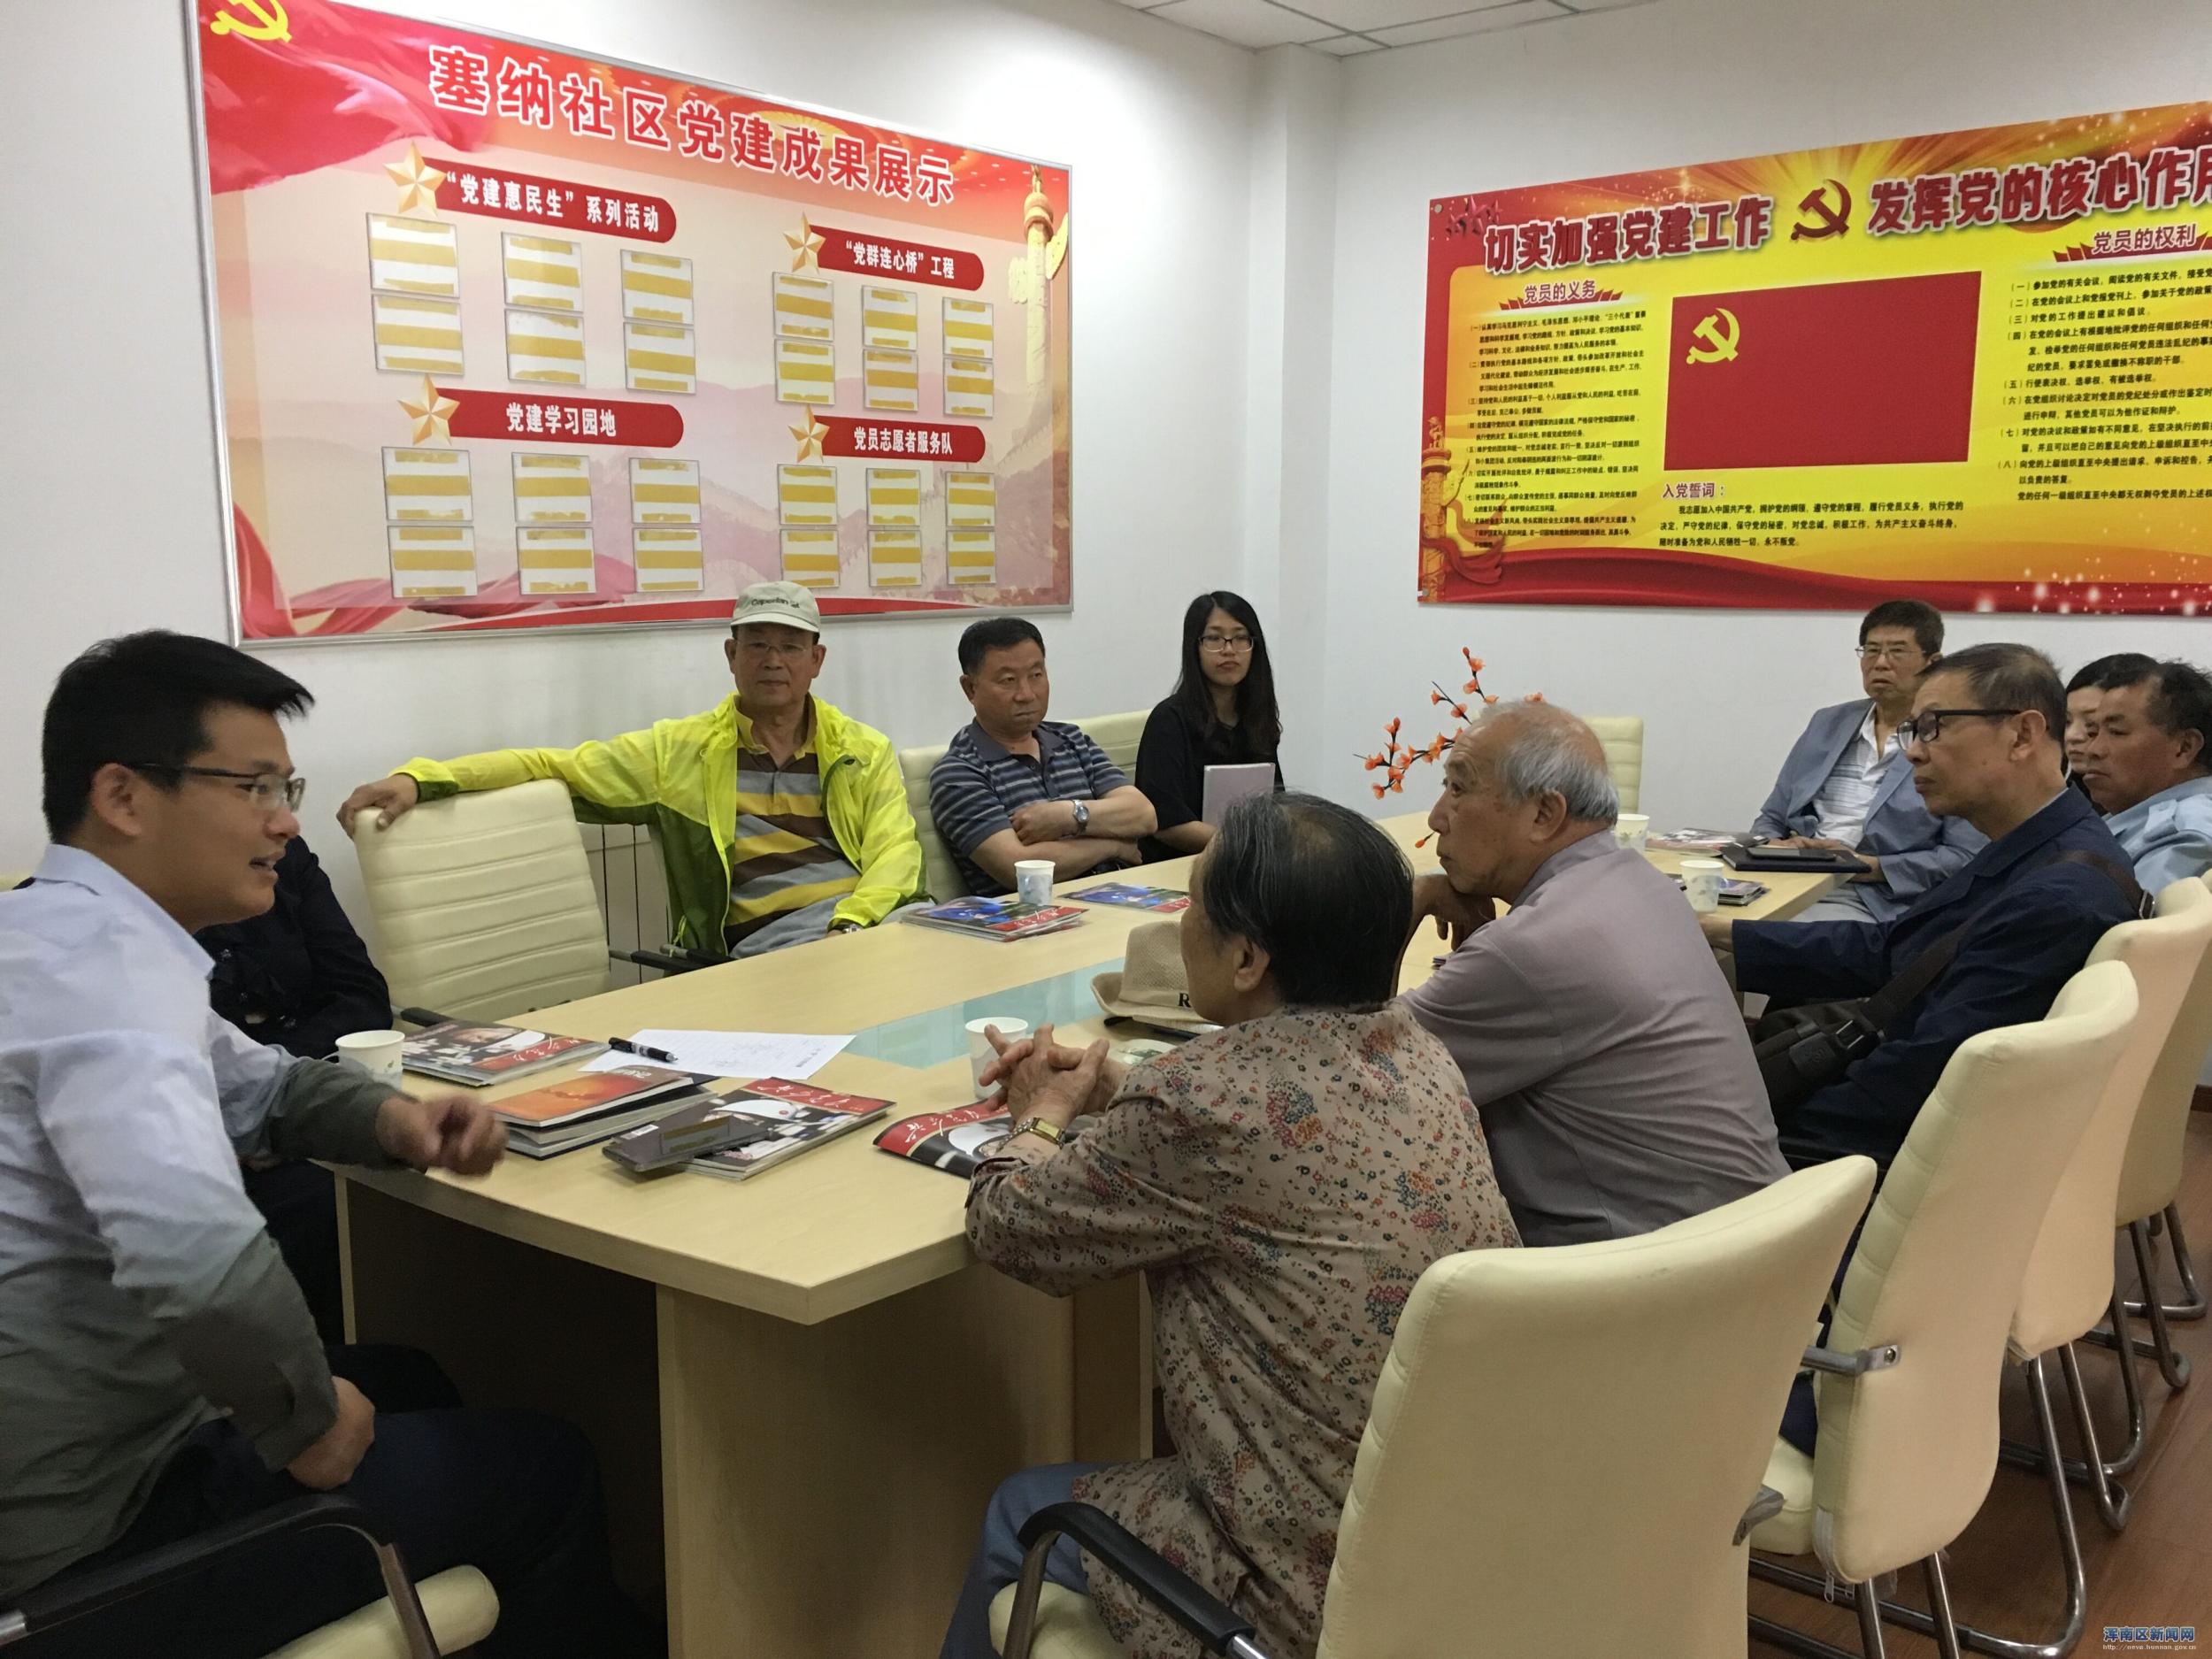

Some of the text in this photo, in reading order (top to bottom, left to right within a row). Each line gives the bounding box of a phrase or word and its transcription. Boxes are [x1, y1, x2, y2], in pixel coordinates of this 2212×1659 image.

[429, 44, 956, 207] 塞纳社区党建成果展示
[1483, 194, 1773, 276] 切实加强党建工作
[2092, 223, 2196, 254] 党员的权利
[1524, 280, 1596, 303] 党员的义务
[506, 403, 617, 437] 党建学习园地
[854, 426, 953, 456] 党员志愿者服务队
